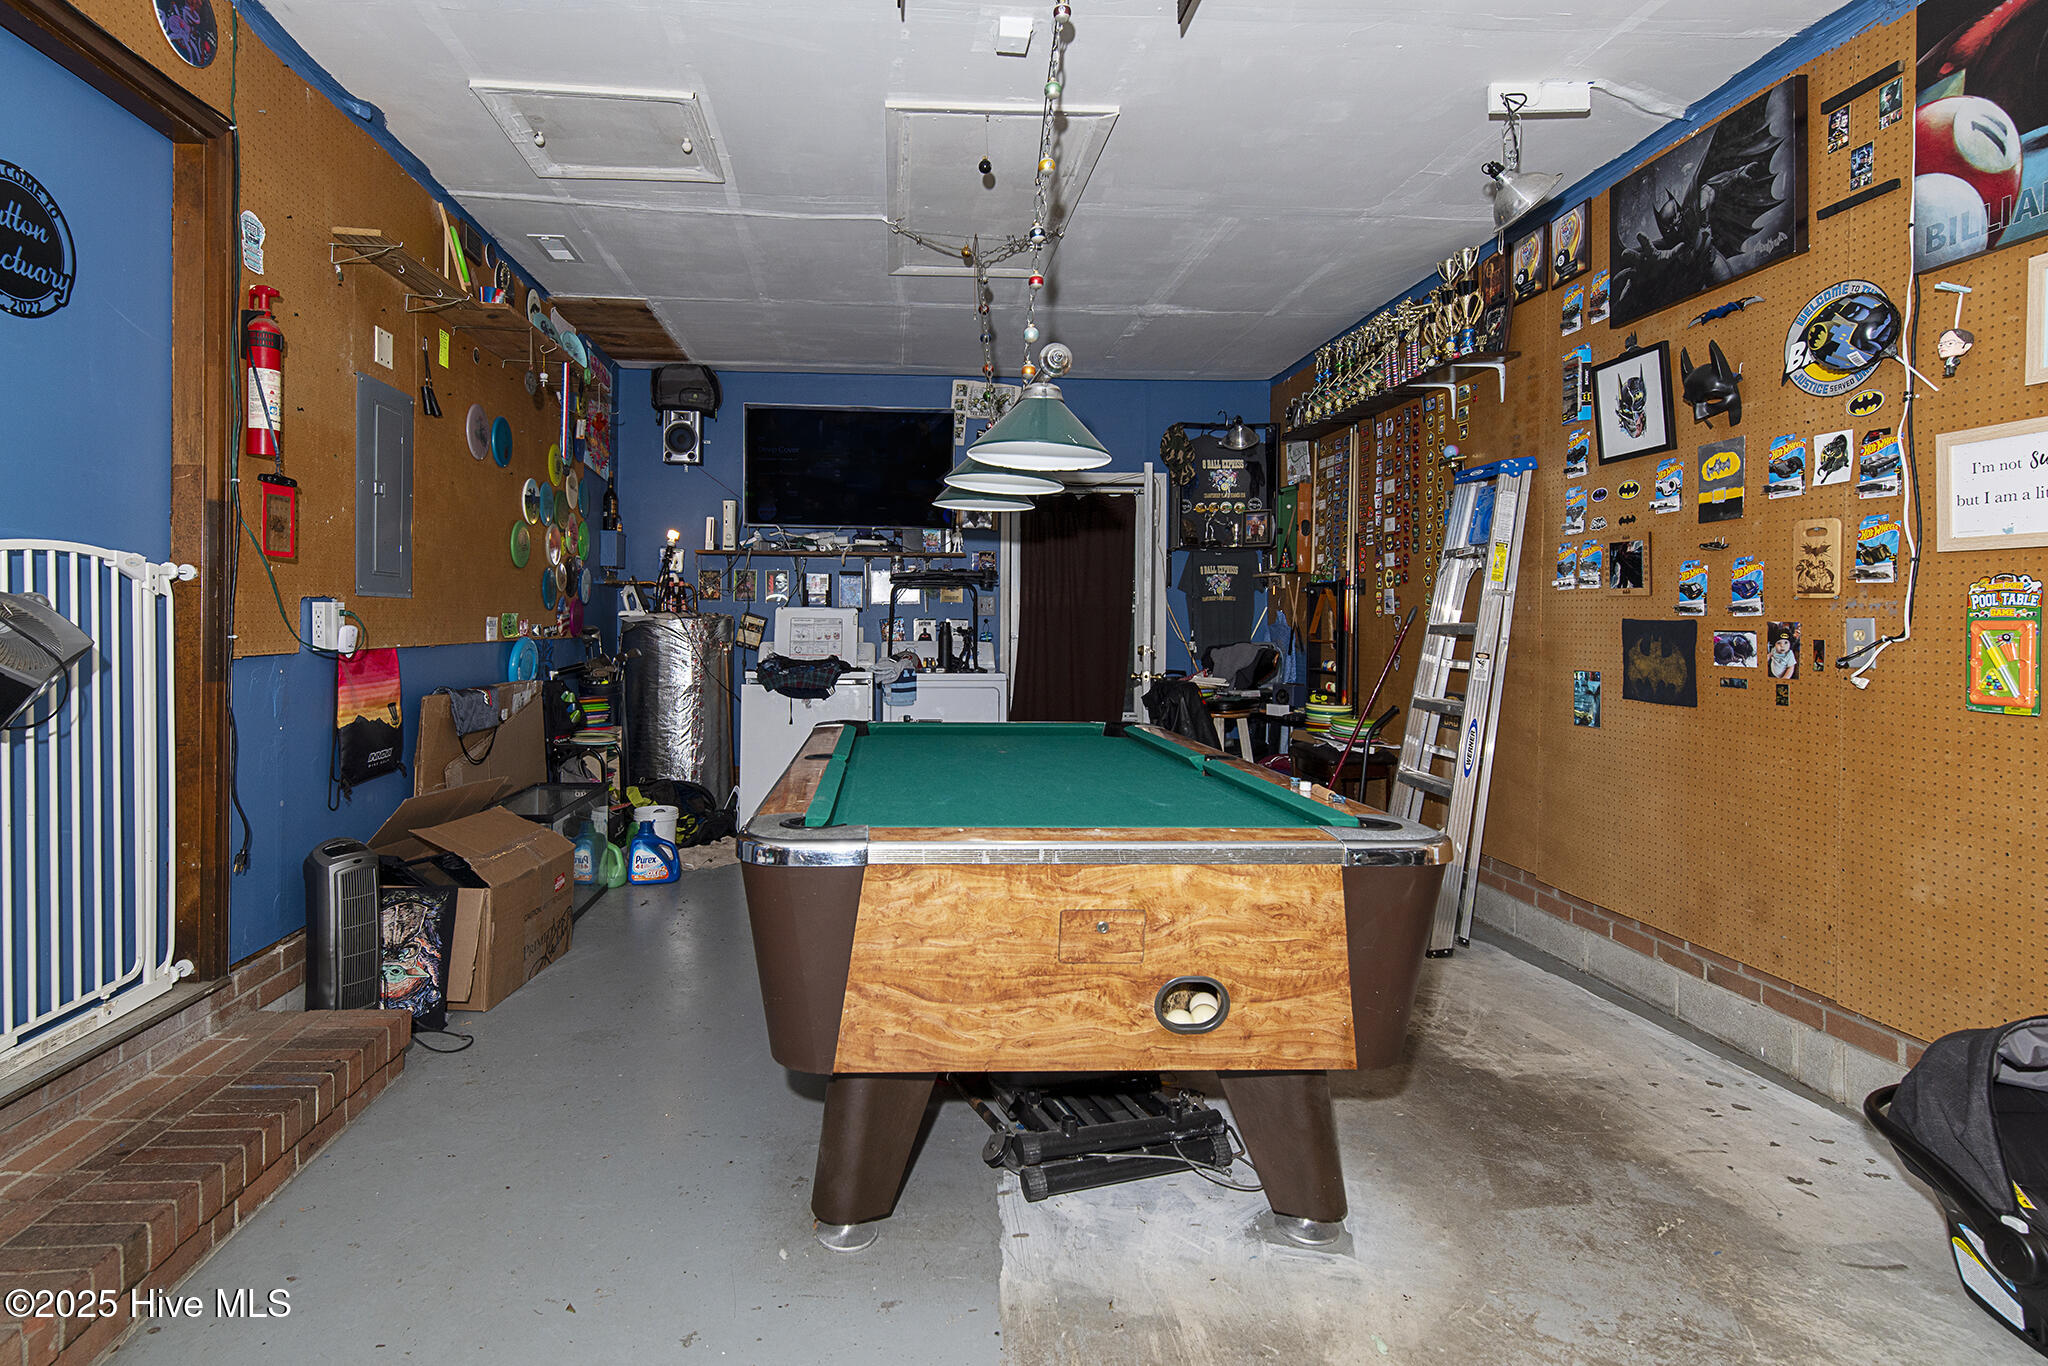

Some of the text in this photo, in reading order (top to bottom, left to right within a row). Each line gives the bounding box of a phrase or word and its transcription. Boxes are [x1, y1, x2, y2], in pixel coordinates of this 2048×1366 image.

[0, 245, 71, 306] ctuary
[1796, 284, 1849, 326] WELCOME
[1793, 373, 1855, 394] JUSTICE SERVED
[1972, 462, 1995, 474] I'm
[2000, 460, 2022, 471] not
[1957, 494, 1979, 506] but
[1984, 491, 1990, 504] I
[1995, 492, 2017, 503] am
[2022, 491, 2030, 500] a
[1970, 591, 2040, 610] POOL TABLE
[1990, 608, 2016, 617] GAME
[1466, 729, 1476, 766] WERNER
[635, 855, 656, 864] Purex
